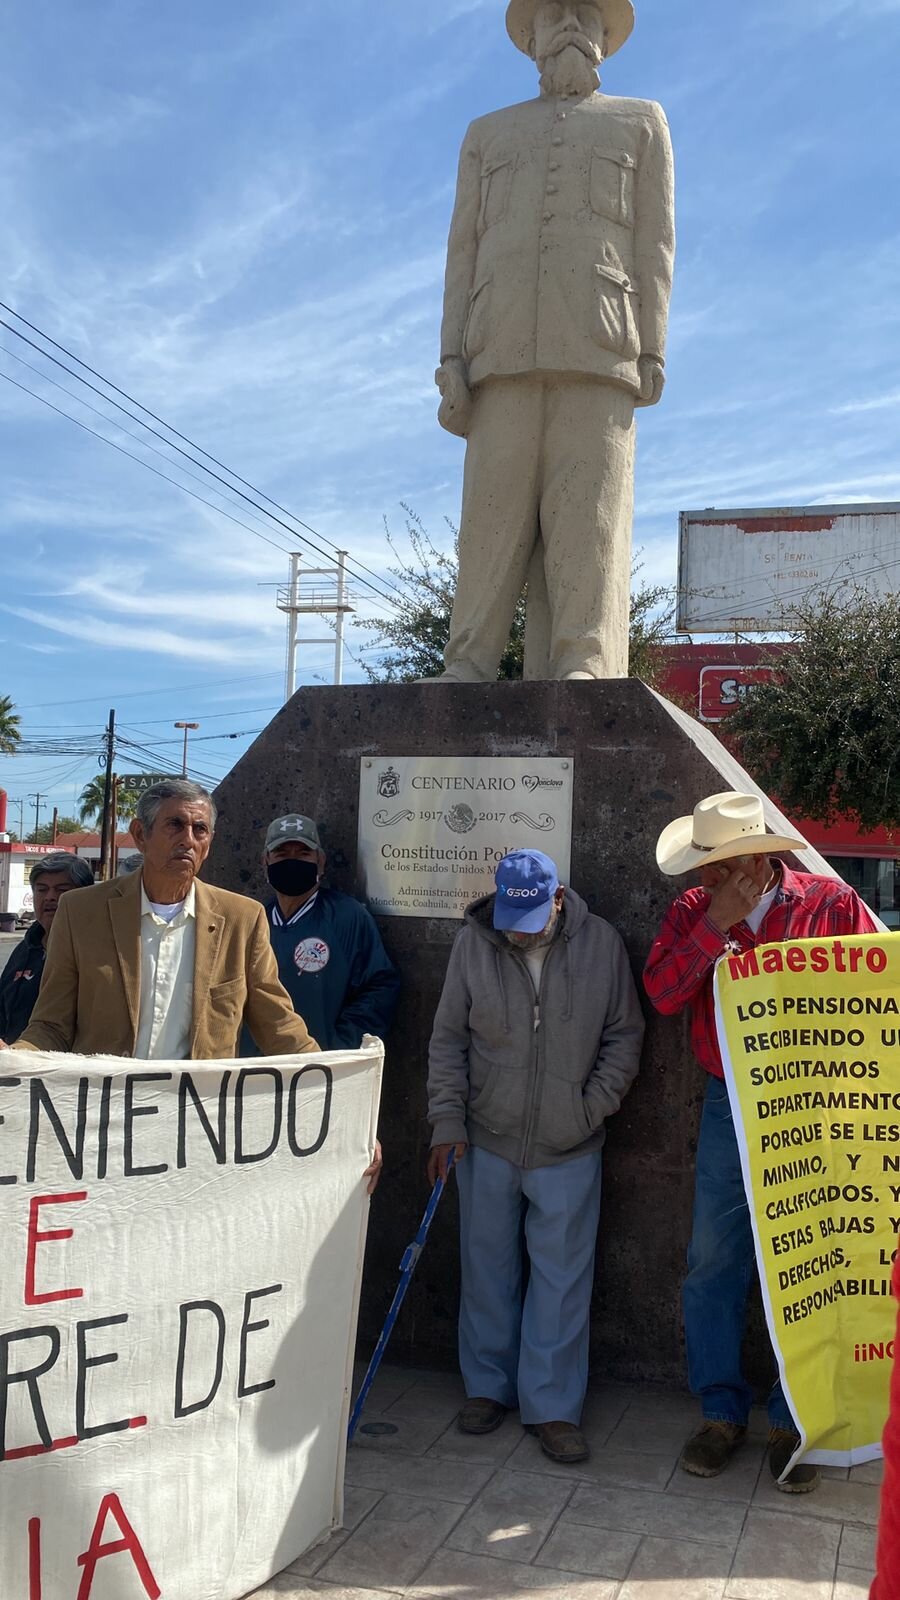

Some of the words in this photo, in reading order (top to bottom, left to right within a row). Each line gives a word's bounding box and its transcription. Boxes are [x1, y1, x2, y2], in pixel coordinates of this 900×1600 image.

[411, 776, 516, 791] CENTENARIO
[419, 811, 443, 821] 1917
[479, 812, 506, 822] 2017
[381, 843, 478, 861] Constitución
[384, 861, 396, 871] de
[397, 861, 411, 872] los
[413, 862, 449, 873] Estados
[451, 864, 485, 874] Unidos
[370, 897, 411, 908] Monclova,
[412, 898, 451, 909] Coahuila,
[459, 902, 465, 911] 5
[398, 886, 469, 898] Administración
[727, 940, 888, 981] Maestro
[737, 998, 777, 1022] LOS
[783, 997, 900, 1015] PENSIONA
[743, 1029, 865, 1053] RECIBIENDO
[881, 1029, 900, 1046] U
[750, 1061, 880, 1086] SOLICITAMOS
[761, 1123, 823, 1153] PORQUE
[830, 1123, 855, 1140] SE
[863, 1124, 900, 1142] LES
[763, 1155, 828, 1187] MINIMO,
[846, 1153, 862, 1171] Y
[883, 1155, 900, 1172] N
[765, 1184, 880, 1220] CALIFICADOS.
[24, 1191, 88, 1306] E
[771, 1224, 814, 1256] ESTAS
[819, 1216, 875, 1239] BAJAS
[778, 1247, 852, 1291] DERECHOS,
[174, 1283, 283, 1419] DE
